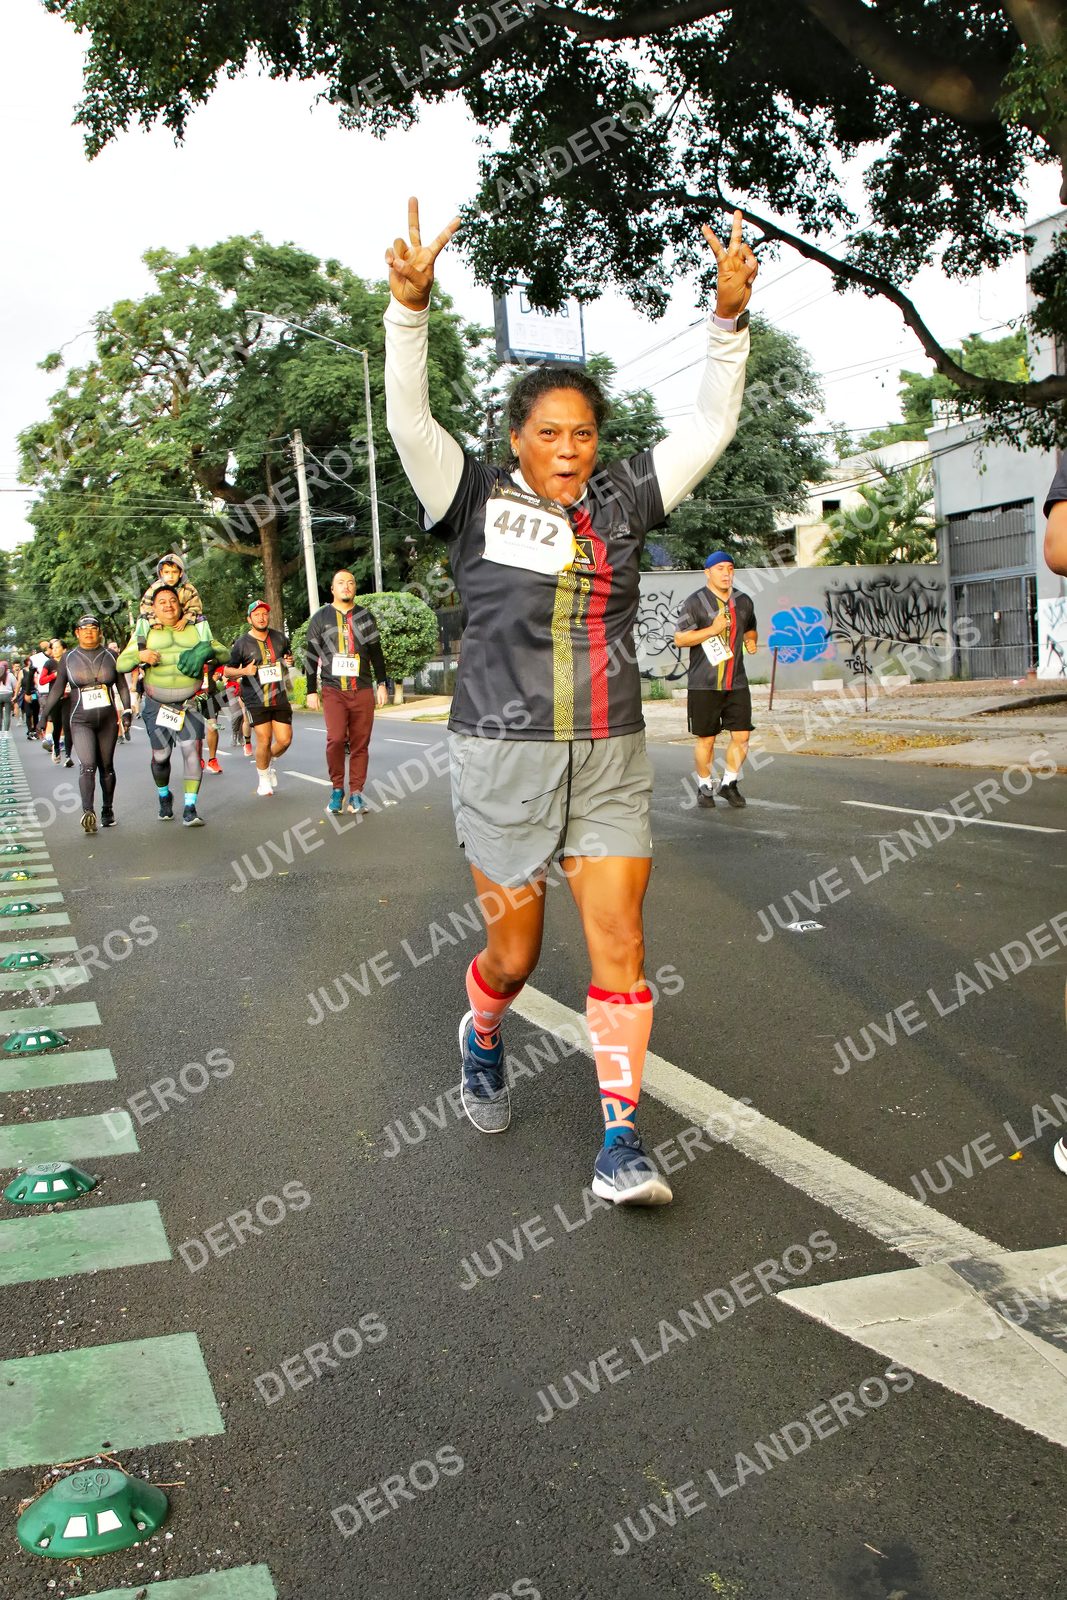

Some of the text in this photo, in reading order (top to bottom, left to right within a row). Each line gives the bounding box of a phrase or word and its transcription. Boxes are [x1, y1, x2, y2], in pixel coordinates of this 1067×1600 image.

[494, 510, 559, 547] 4412
[709, 637, 723, 657] 3521
[336, 660, 355, 669] 1216
[88, 692, 102, 701] 204
[161, 711, 179, 724] 5996
